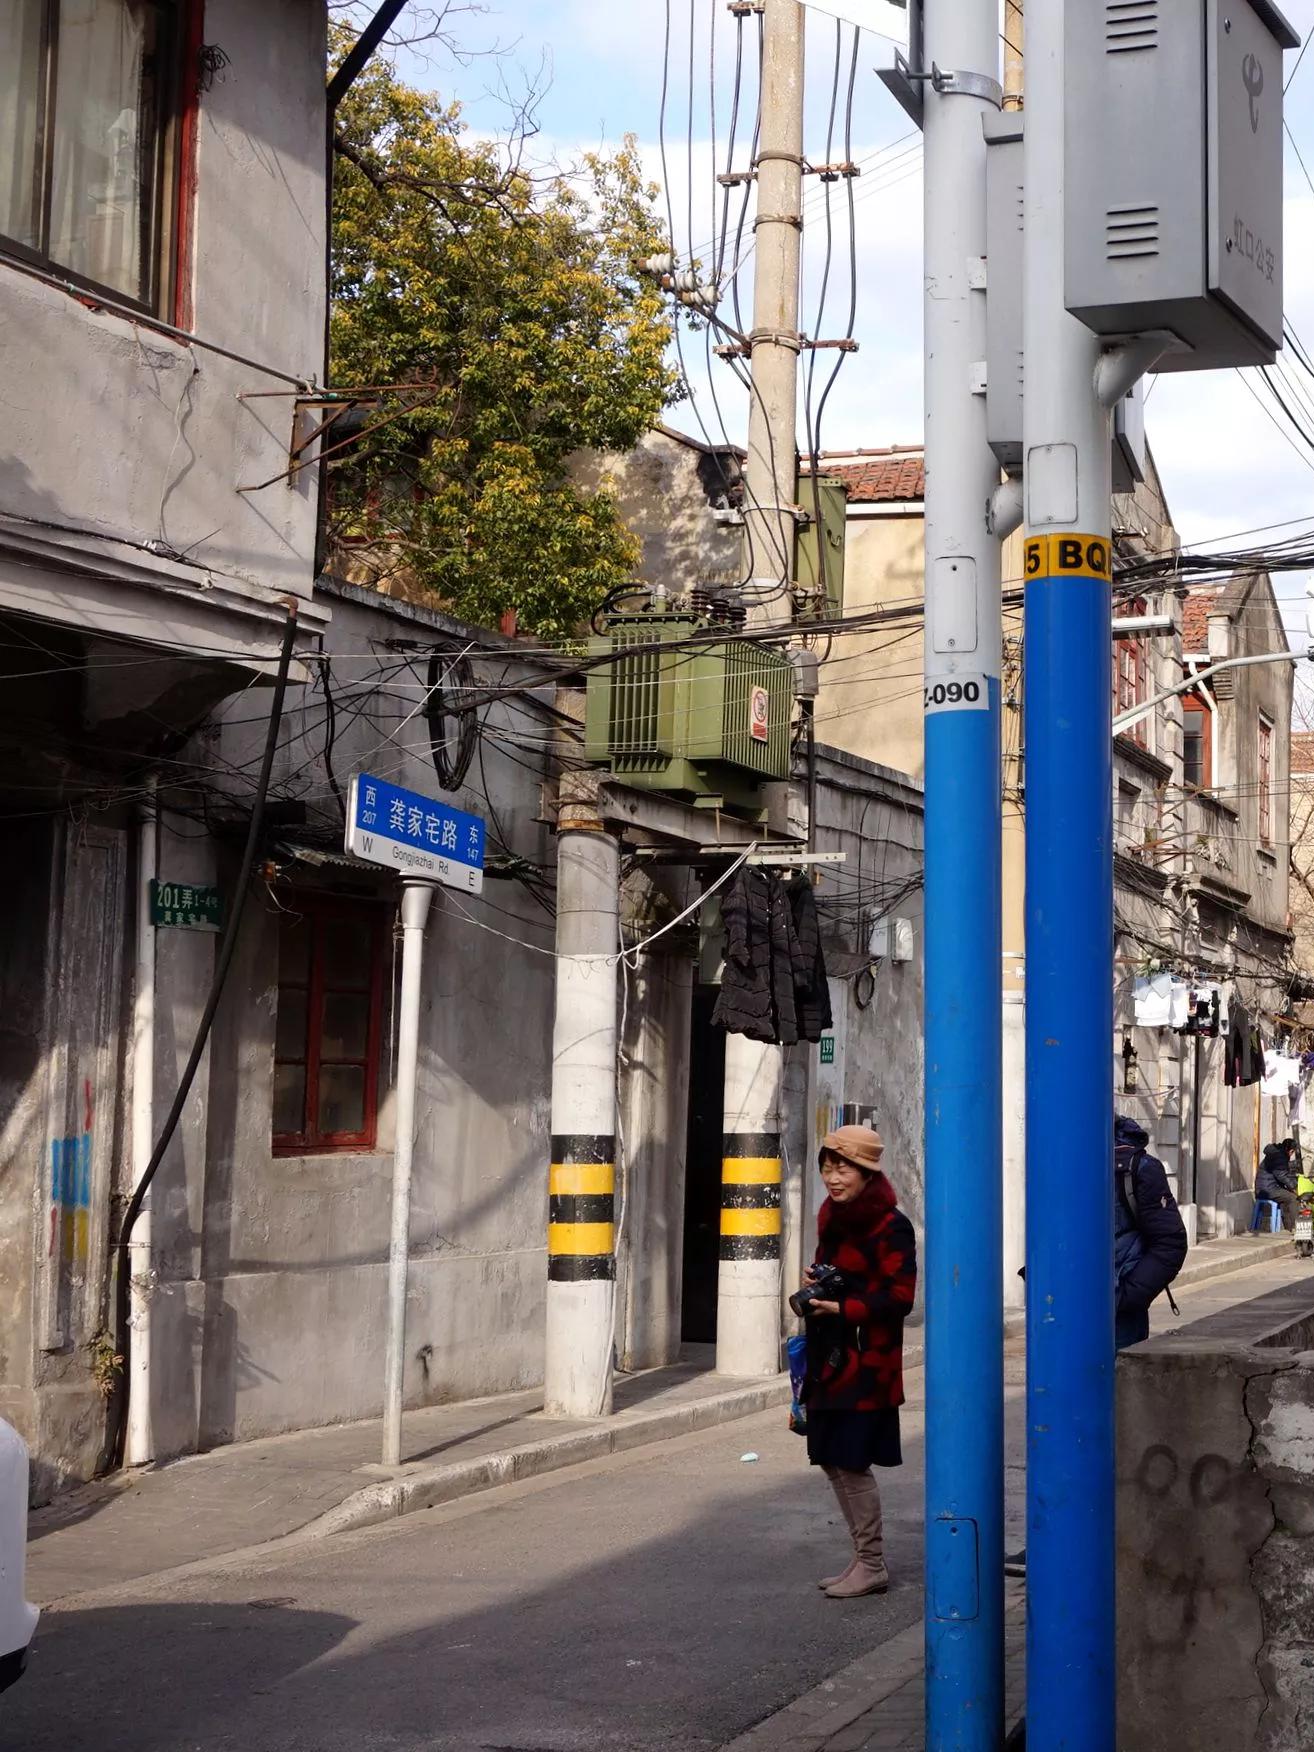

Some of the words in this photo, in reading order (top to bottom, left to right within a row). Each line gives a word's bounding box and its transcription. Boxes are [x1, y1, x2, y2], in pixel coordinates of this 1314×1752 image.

[1024, 543, 1041, 575] 5
[1058, 540, 1111, 577] BQ
[365, 785, 377, 807] 西
[362, 809, 377, 825] 207
[389, 798, 458, 852] 龚家宅路
[469, 825, 479, 844] 东
[362, 836, 374, 853] W
[467, 847, 479, 861] 147
[392, 846, 435, 870] Gongjiazhai
[468, 871, 475, 887] E
